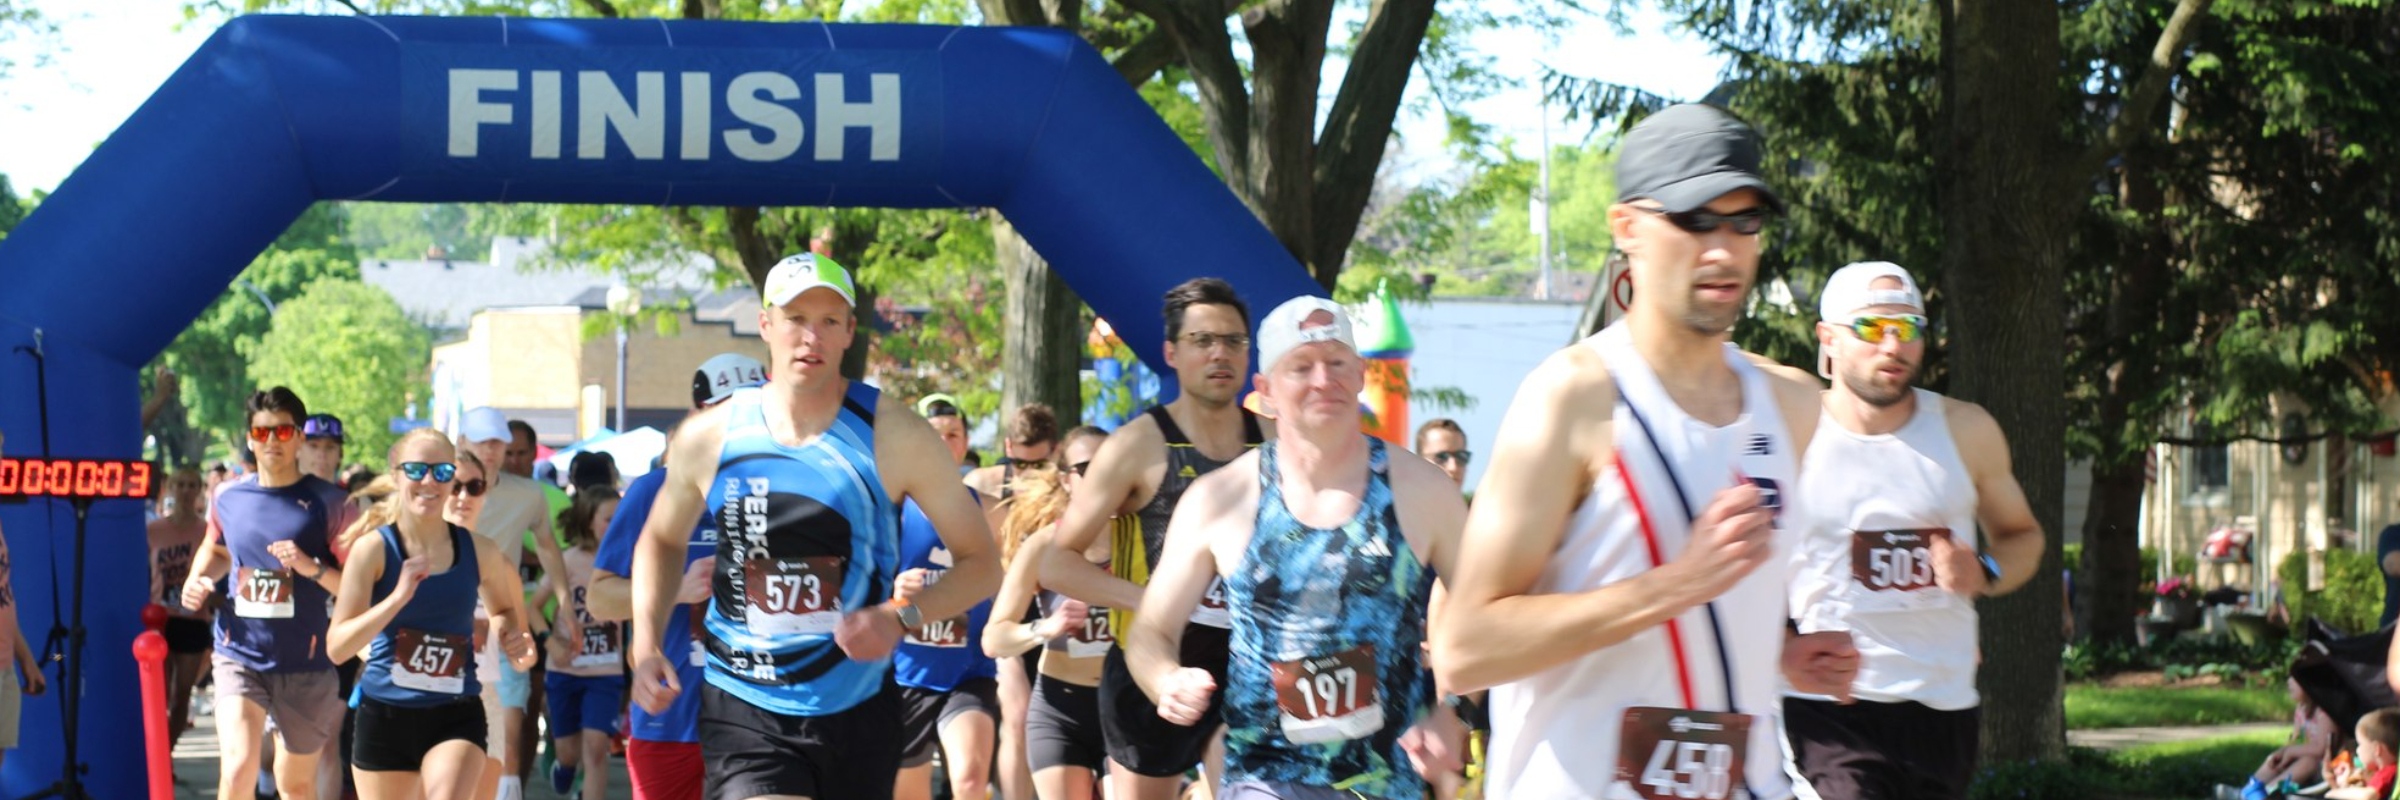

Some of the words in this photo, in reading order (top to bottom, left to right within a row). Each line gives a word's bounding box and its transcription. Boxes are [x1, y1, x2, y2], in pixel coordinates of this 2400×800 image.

[447, 68, 901, 162] FINISH
[717, 366, 760, 387] 414
[0, 459, 150, 497] 00:00:03
[1870, 547, 1933, 587] 503
[248, 578, 281, 602] 127
[765, 574, 822, 611] 573
[922, 620, 955, 642] 104
[409, 645, 453, 674] 457
[1295, 667, 1357, 718] 197
[1640, 739, 1734, 799] 458
